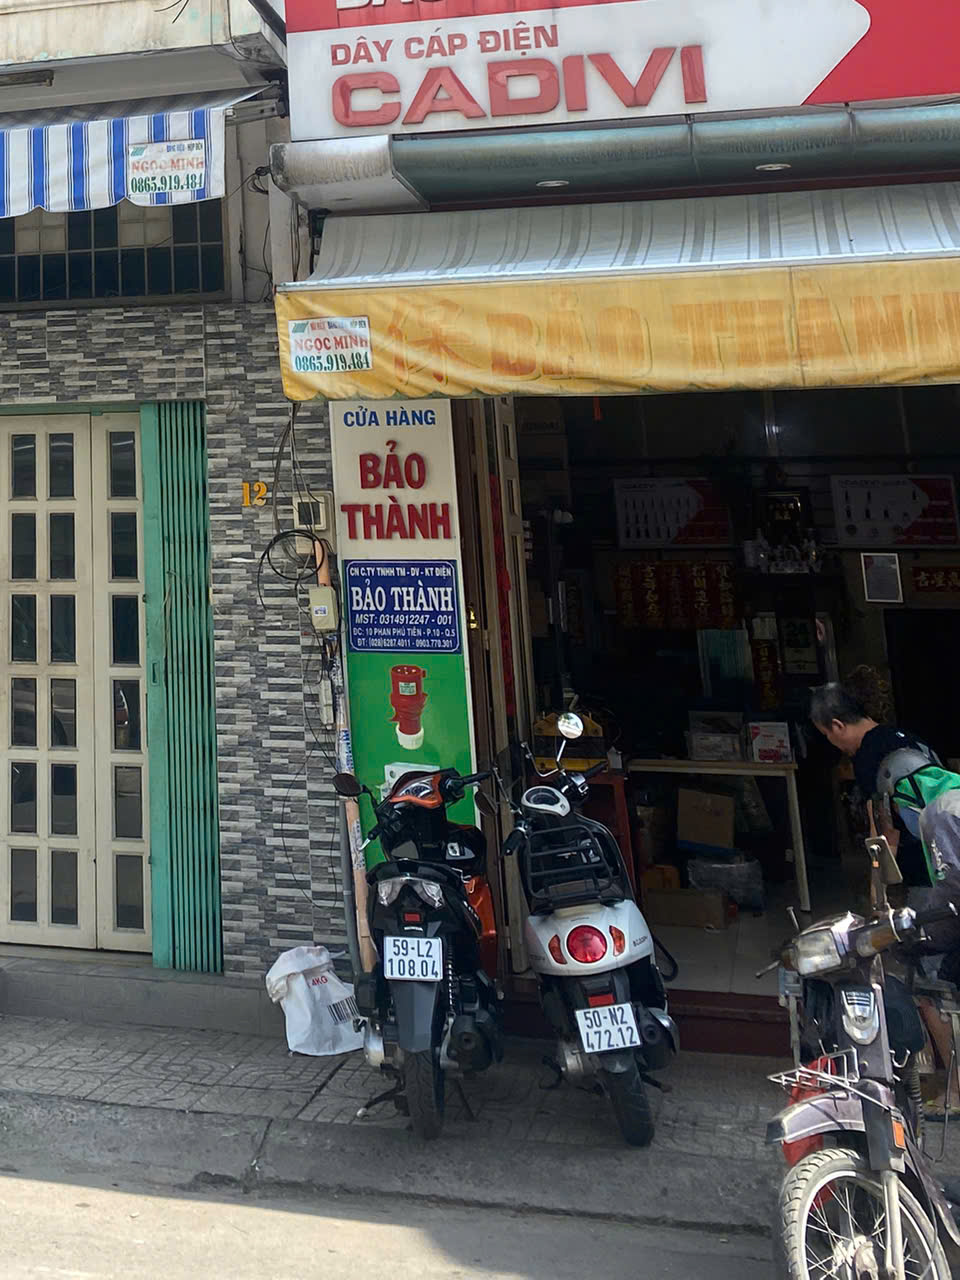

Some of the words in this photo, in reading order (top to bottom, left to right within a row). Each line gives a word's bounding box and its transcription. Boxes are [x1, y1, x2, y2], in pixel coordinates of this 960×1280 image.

[331, 36, 393, 66] DÂY
[404, 27, 468, 60] CÁP
[477, 21, 559, 57] ĐIỆN
[332, 45, 708, 128] CADIVI
[294, 337, 332, 354] NGỌC
[333, 334, 368, 350] MINH
[295, 351, 370, 372] 0865.919.484
[343, 405, 380, 427] CỬA
[386, 406, 436, 426] HÀNG
[359, 440, 426, 489] BẢO
[241, 481, 267, 507] 12
[341, 495, 452, 540] THÀNH
[360, 567, 375, 577] C.TY
[376, 567, 394, 577] TNHH
[396, 567, 406, 577] TM
[351, 578, 386, 611] BẢO
[390, 580, 454, 611] THÀNH
[355, 614, 378, 624] MST:
[379, 614, 430, 625] 0314912247
[437, 615, 452, 625] 001
[374, 628, 392, 636] PHAN
[445, 628, 456, 637] Q.5
[393, 938, 433, 958] 59-L2
[387, 958, 439, 978] 108.04
[583, 1006, 628, 1029] 50-N2
[585, 1027, 637, 1051] 472.12
